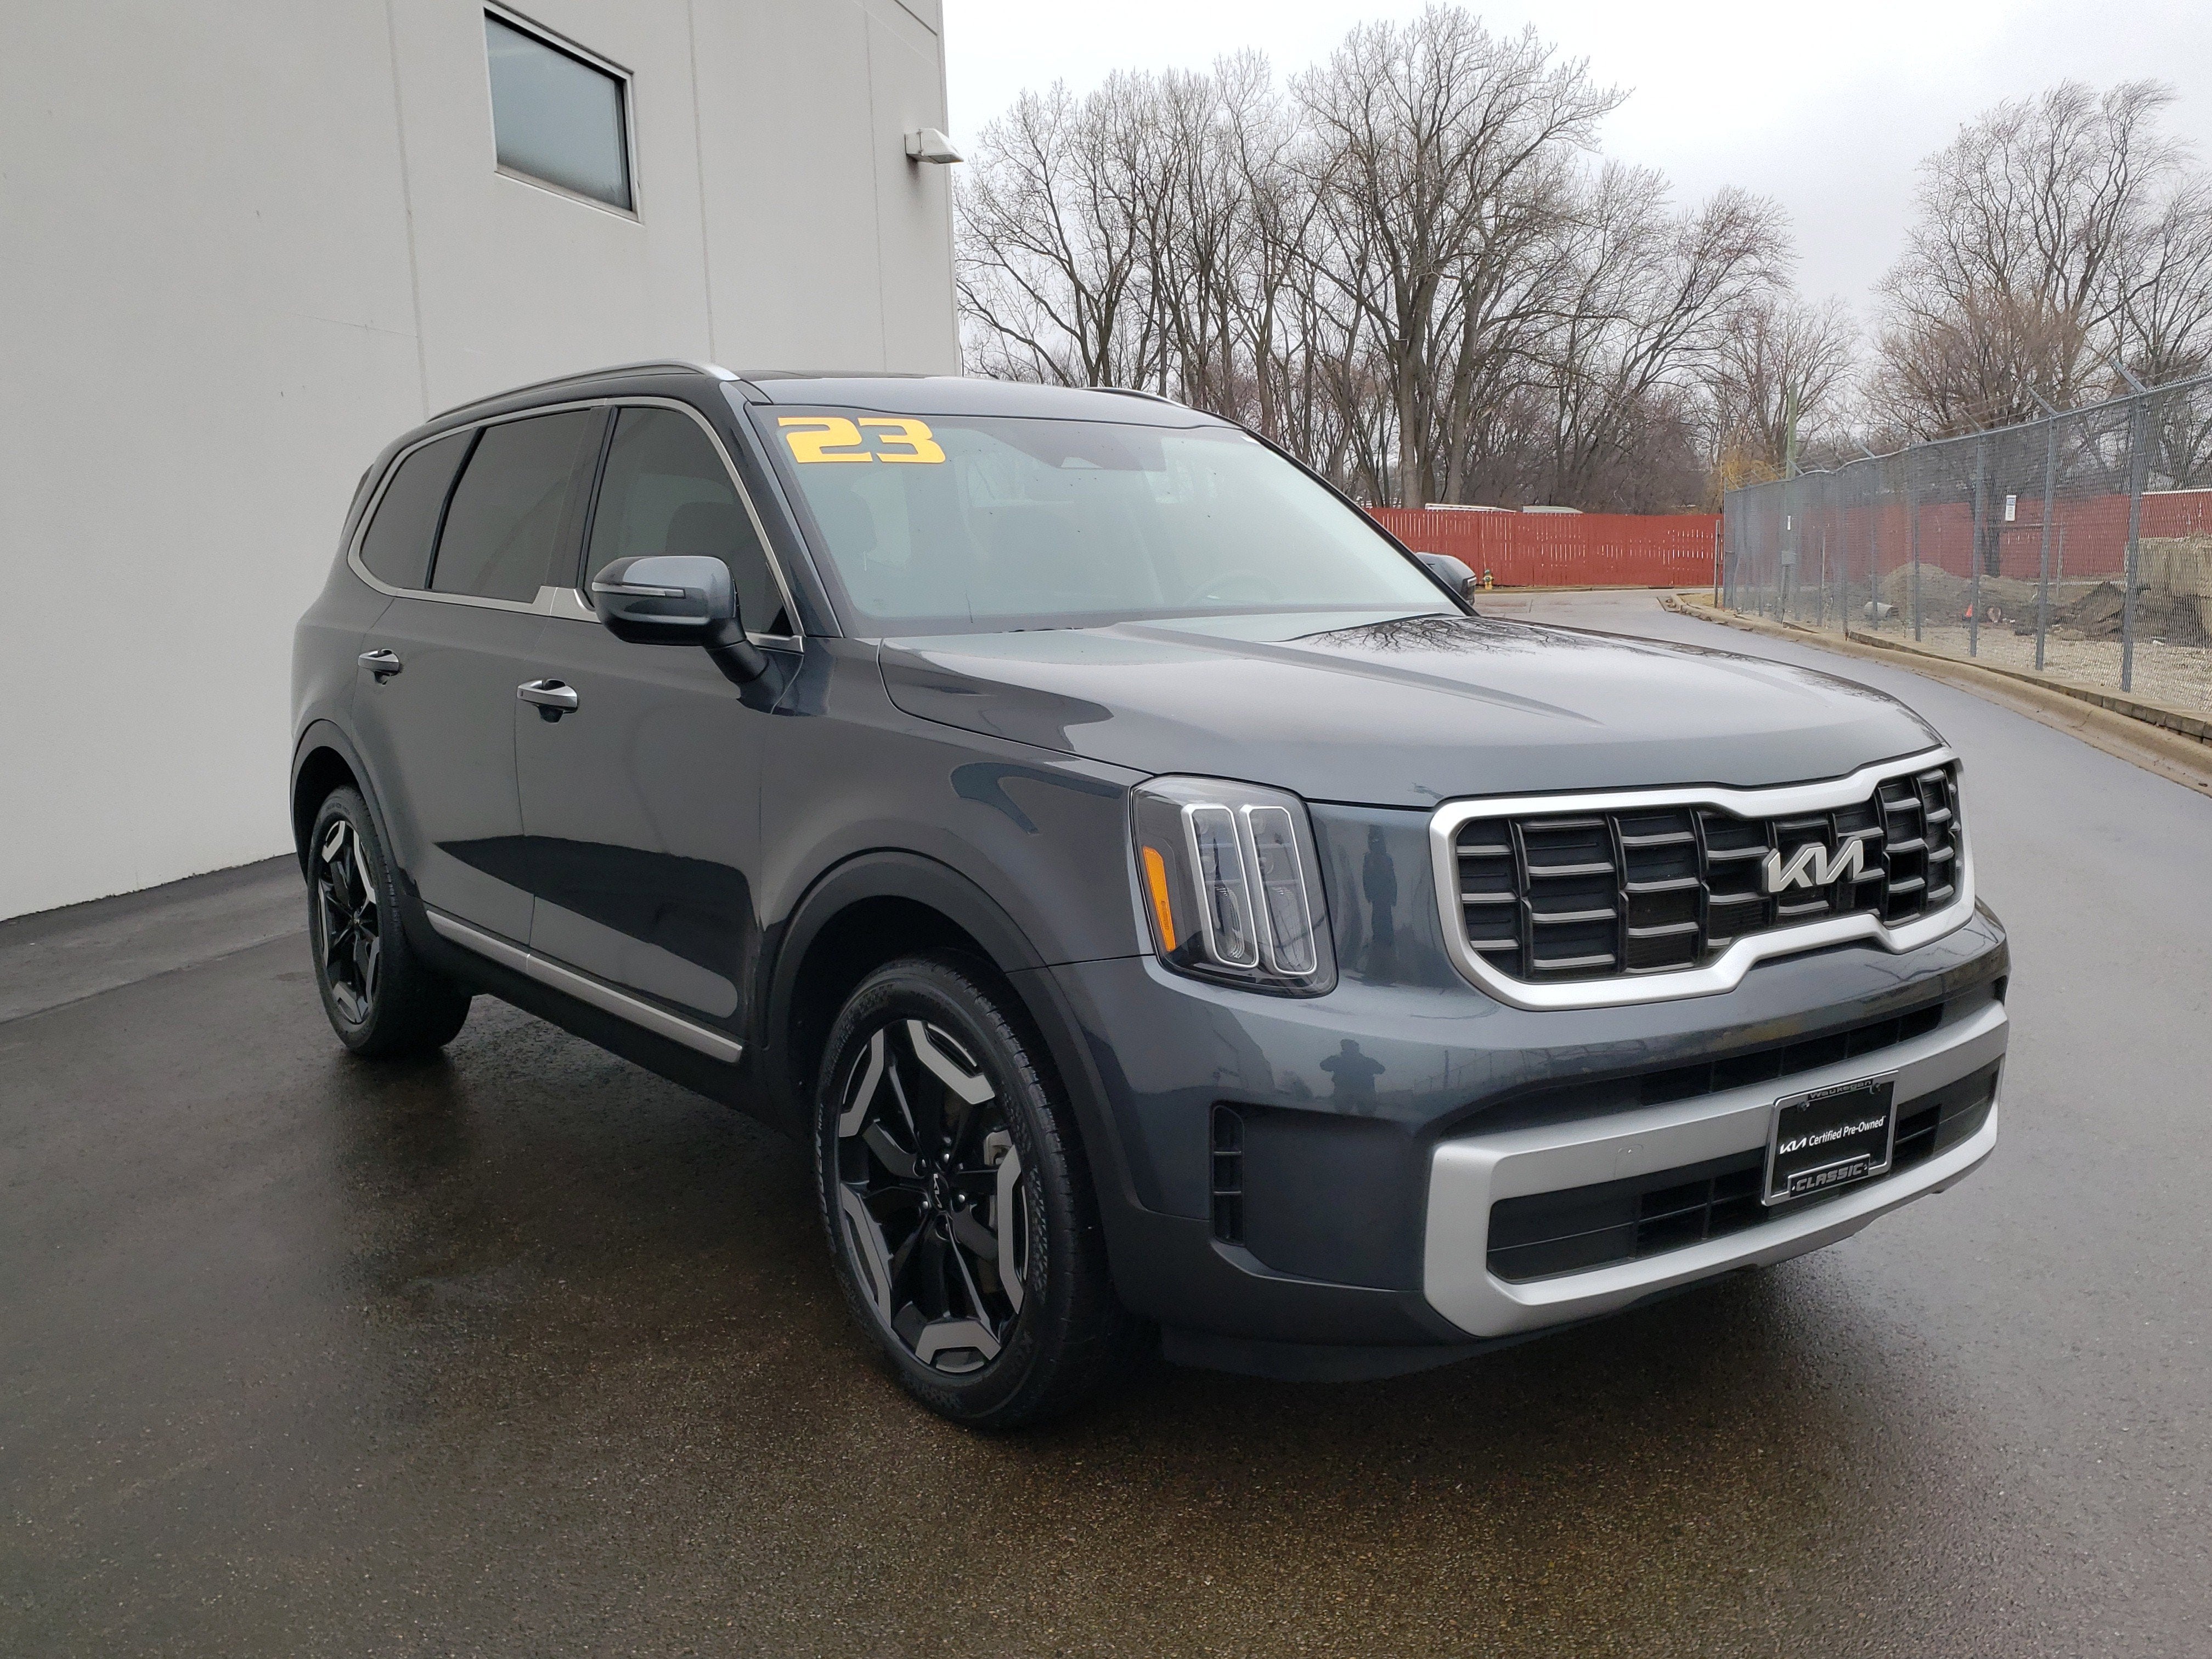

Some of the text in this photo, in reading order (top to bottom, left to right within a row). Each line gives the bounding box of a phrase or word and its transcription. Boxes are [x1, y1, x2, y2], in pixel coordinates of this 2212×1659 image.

[777, 417, 946, 464] 23
[1762, 836, 1864, 893] KIA
[1780, 1116, 1884, 1154] KIA Certified Pre-Owned
[1796, 1163, 1864, 1192] CLASSIC
